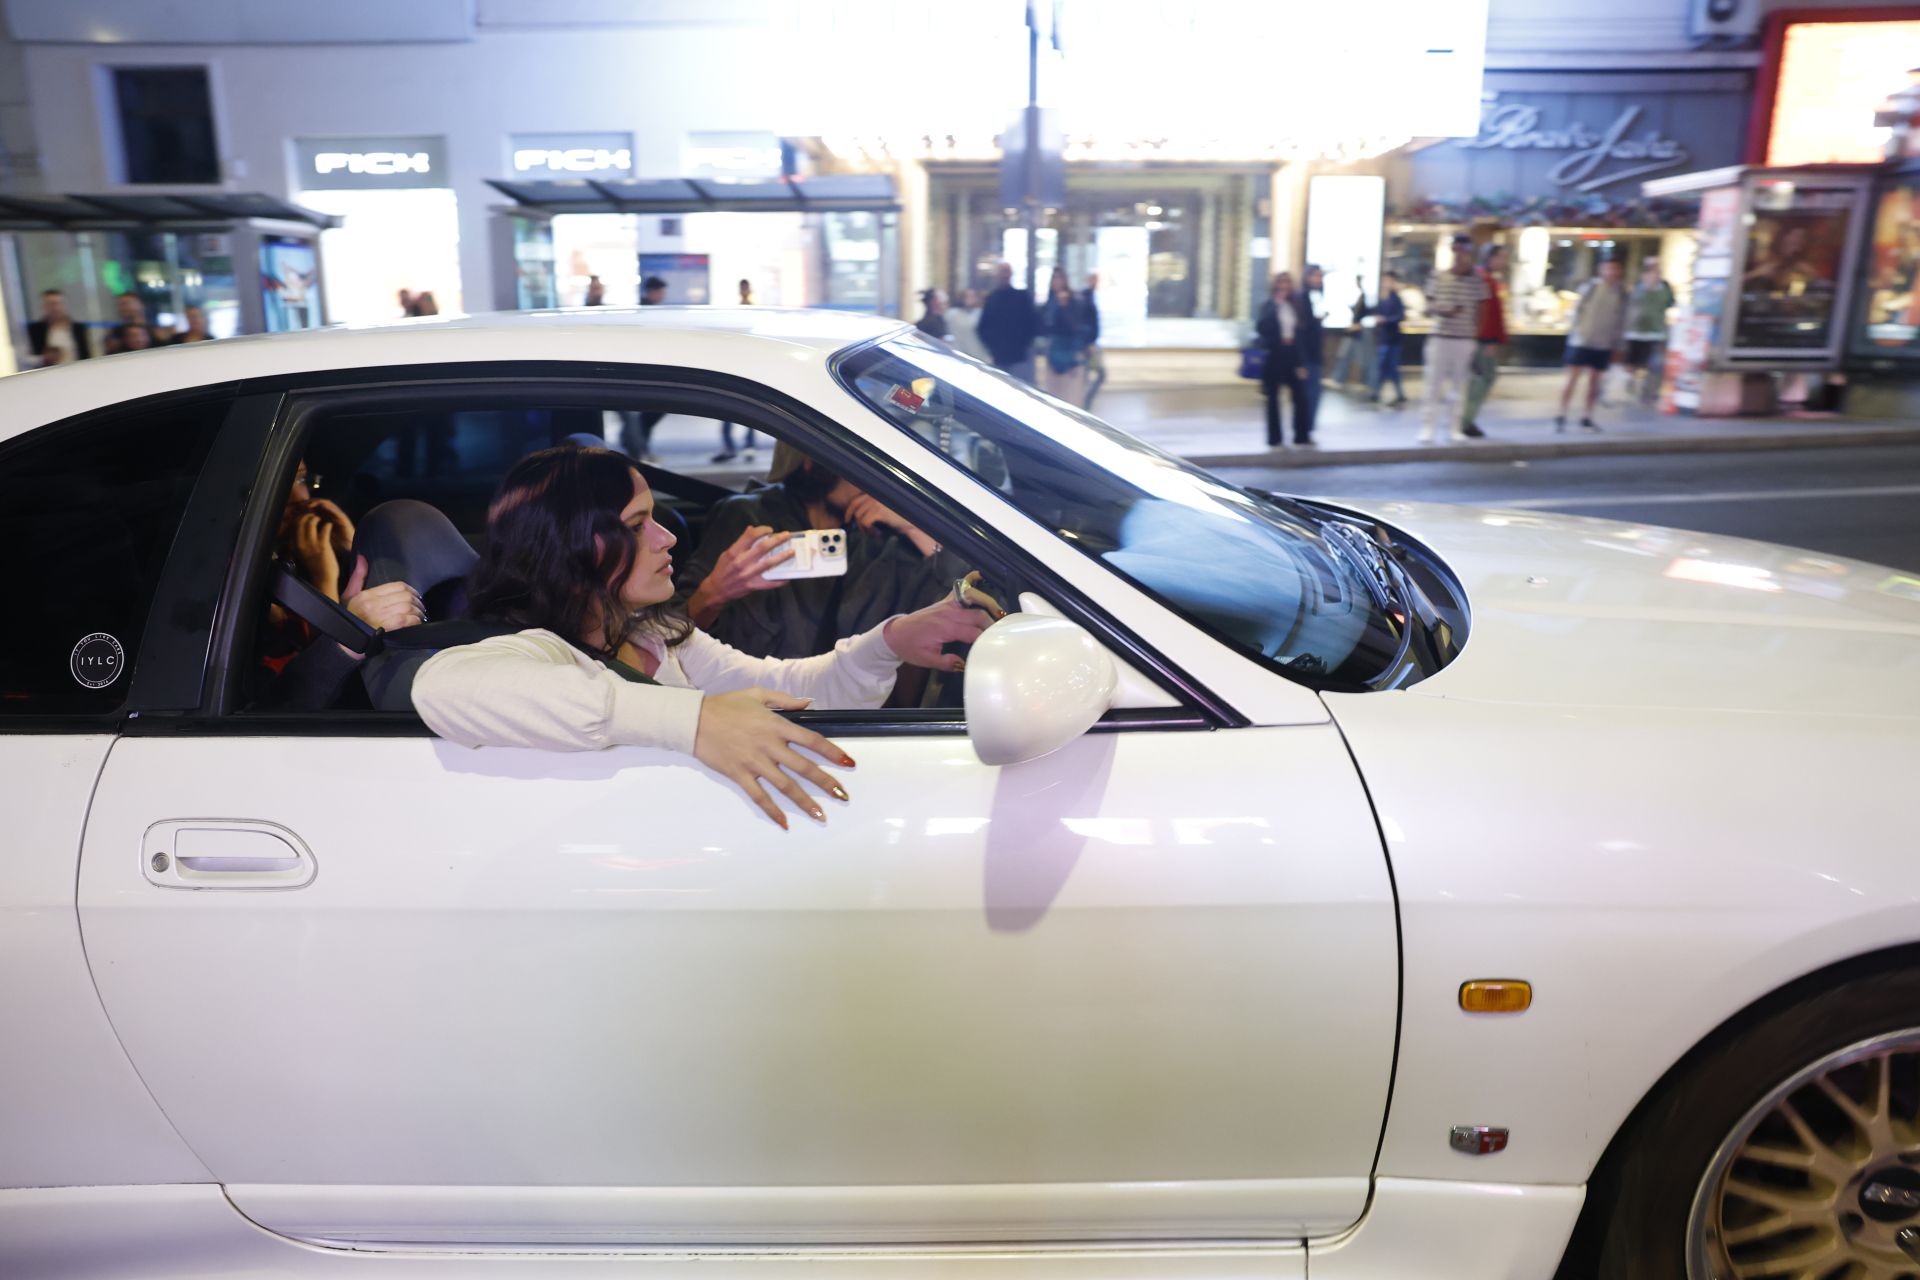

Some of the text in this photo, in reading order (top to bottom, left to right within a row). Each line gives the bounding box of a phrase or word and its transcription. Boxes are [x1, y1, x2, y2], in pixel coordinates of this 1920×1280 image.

[315, 152, 430, 174] PICK
[514, 149, 631, 171] PICK
[81, 656, 115, 666] IYLC
